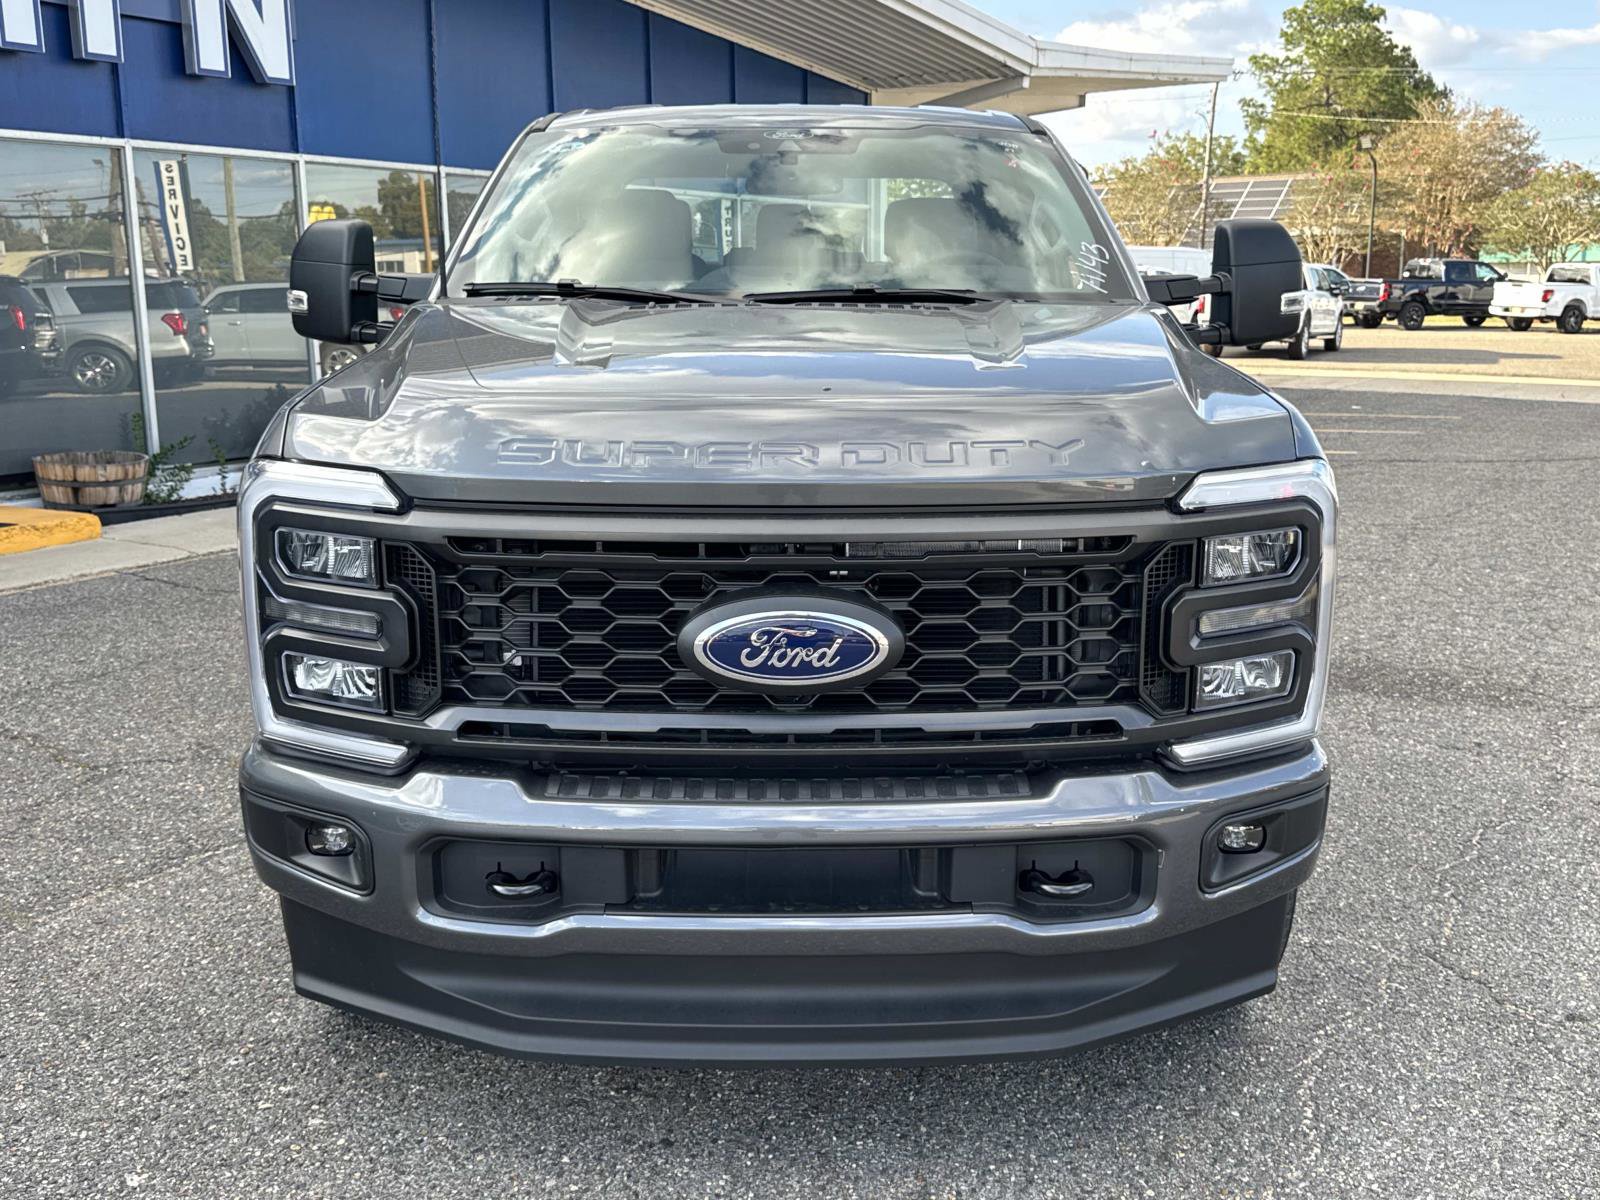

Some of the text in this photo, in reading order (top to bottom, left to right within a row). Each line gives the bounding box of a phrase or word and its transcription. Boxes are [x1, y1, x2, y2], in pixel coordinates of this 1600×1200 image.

[496, 437, 1086, 469] SUPER DUTY
[740, 626, 844, 668] Ford
